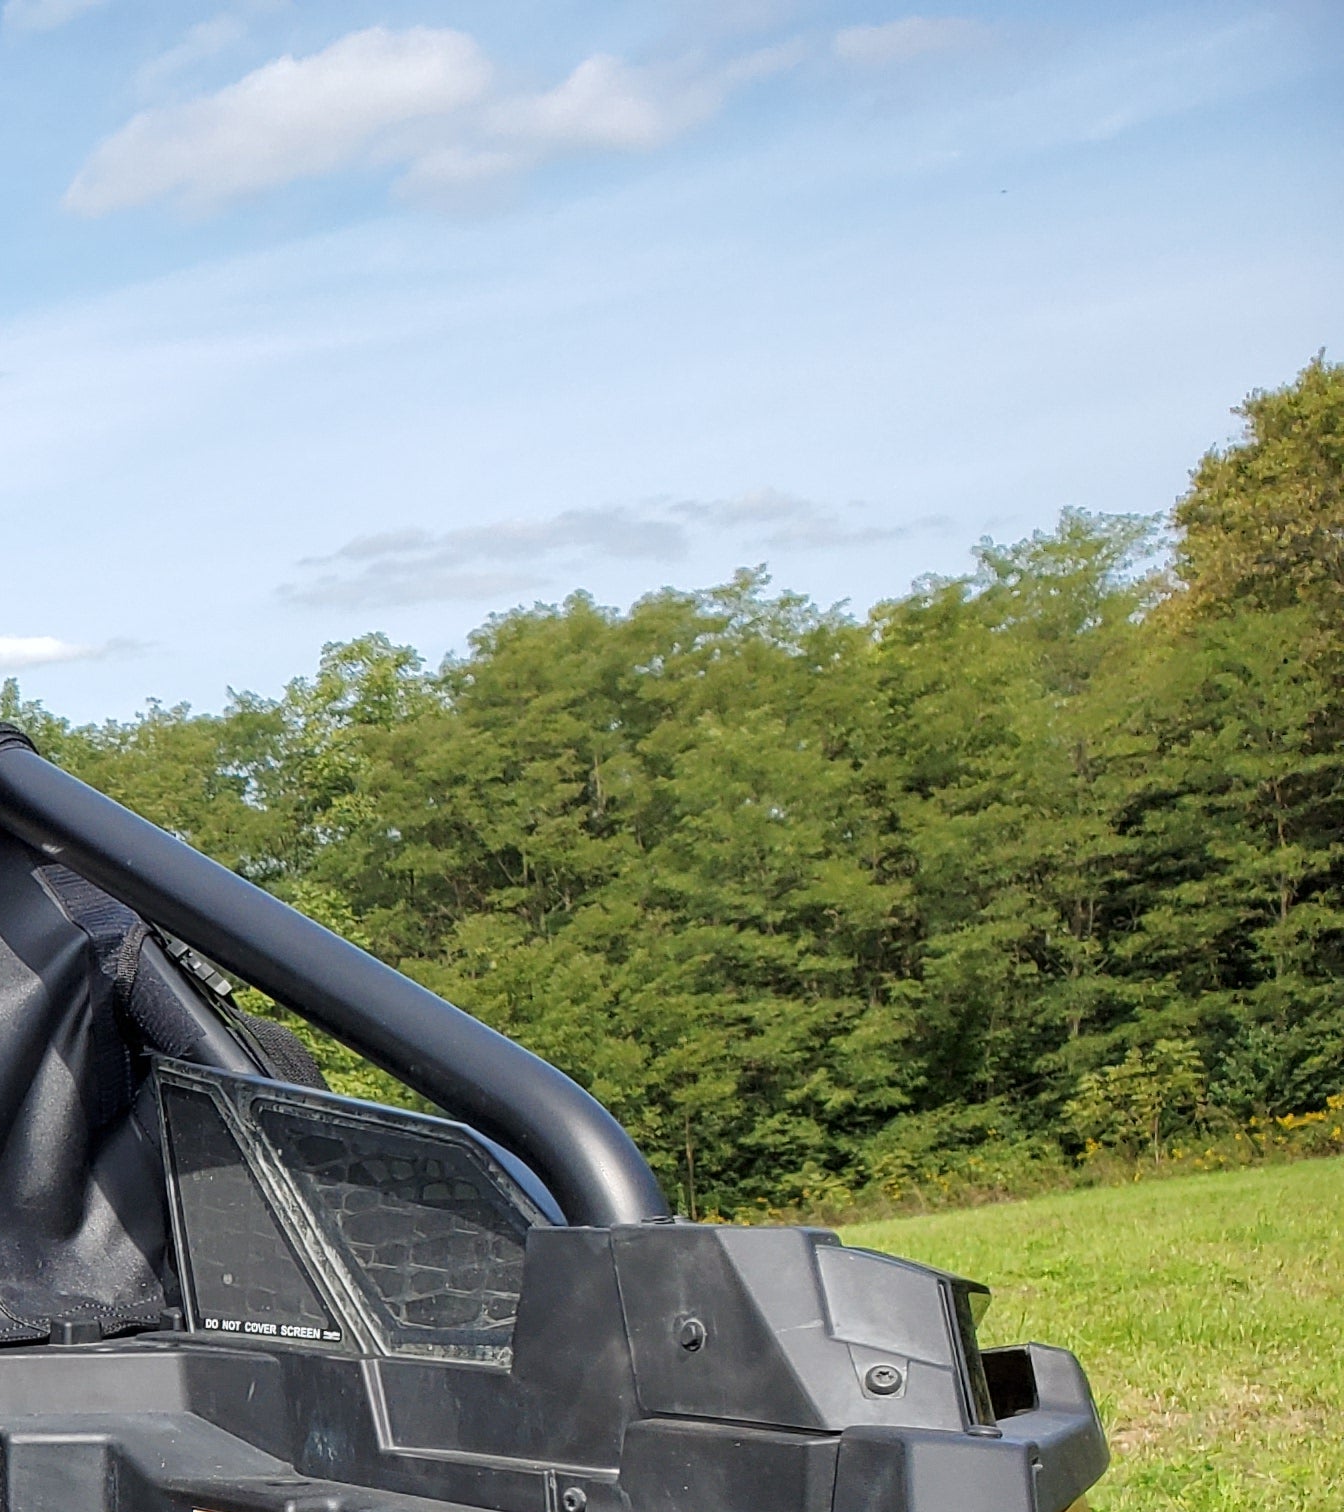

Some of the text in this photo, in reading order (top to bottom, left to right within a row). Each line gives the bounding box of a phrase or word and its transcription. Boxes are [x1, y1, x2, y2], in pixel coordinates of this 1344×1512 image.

[205, 1318, 219, 1329] DO
[222, 1320, 241, 1331] NOT
[244, 1321, 277, 1335] COVER
[280, 1325, 321, 1339] SCREEN
